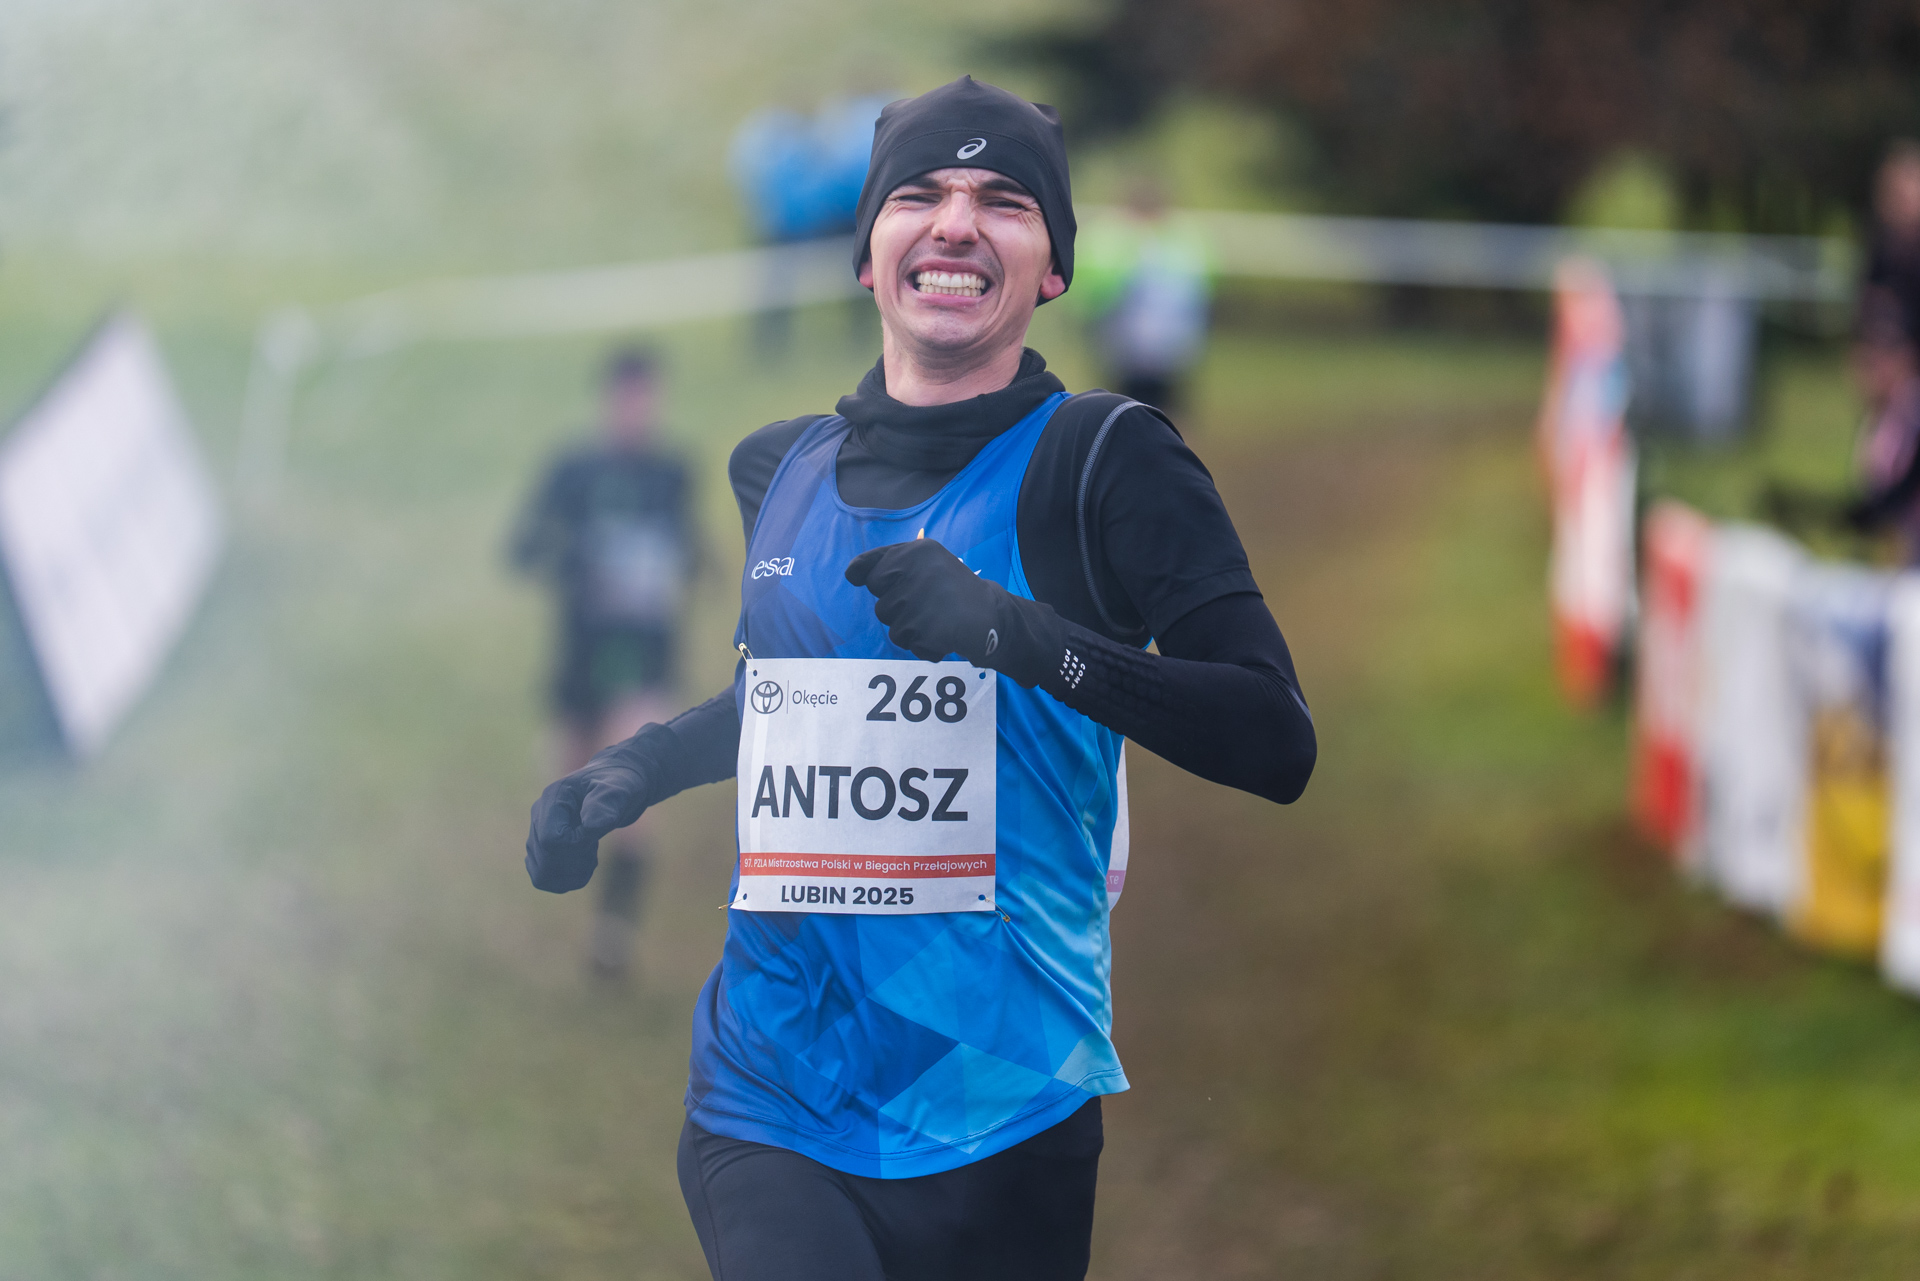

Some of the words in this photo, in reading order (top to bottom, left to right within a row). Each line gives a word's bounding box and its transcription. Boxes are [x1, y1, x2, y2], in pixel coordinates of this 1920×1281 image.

[792, 690, 838, 708] Okęcie
[866, 674, 968, 723] 268
[751, 765, 969, 821] ANTOSZ
[753, 859, 767, 868] PZLA
[768, 858, 819, 869] Mistrzostwa
[821, 860, 851, 869] Polski
[853, 861, 863, 870] w
[865, 860, 911, 873] Biegach
[913, 859, 987, 872] Przełajowych
[781, 885, 846, 904] LUBIN
[852, 886, 914, 905] 2025
